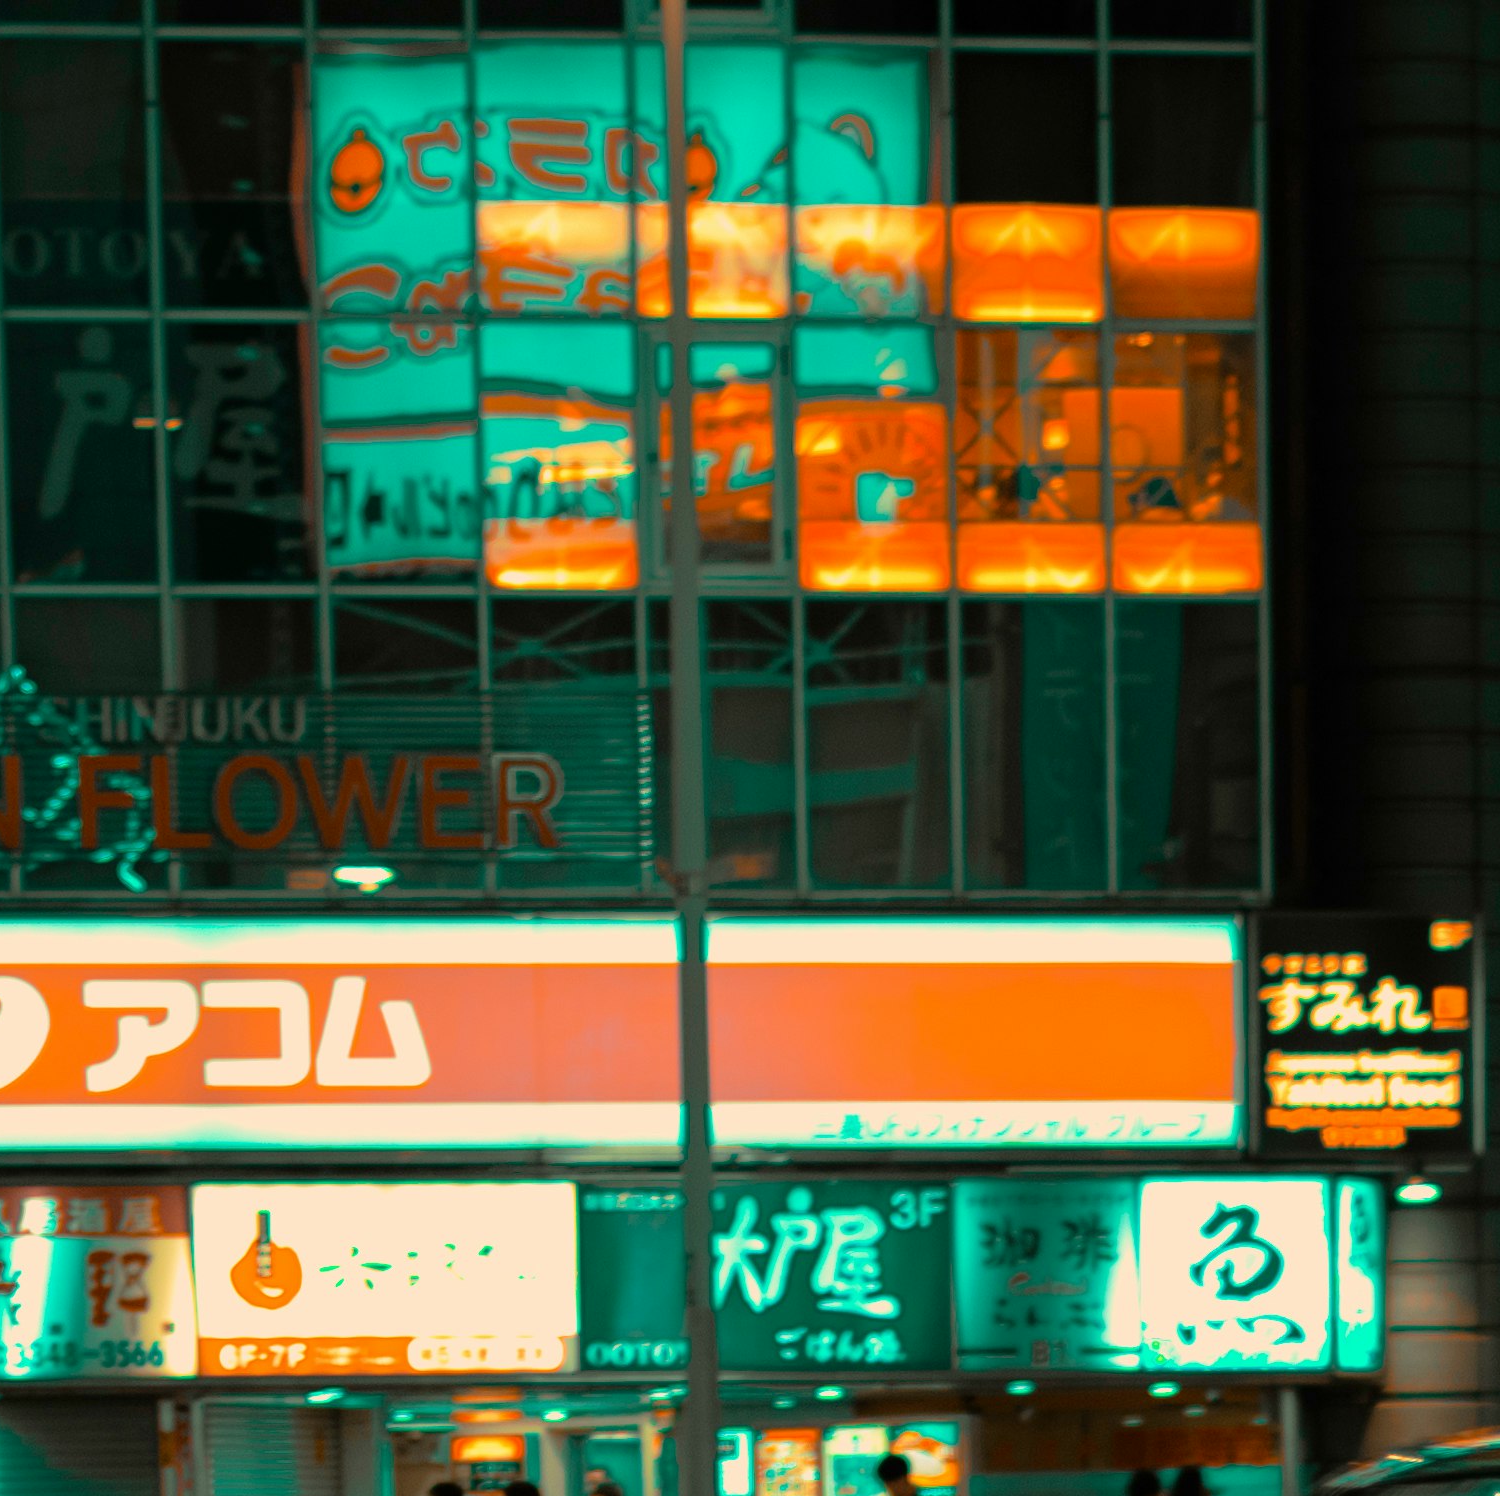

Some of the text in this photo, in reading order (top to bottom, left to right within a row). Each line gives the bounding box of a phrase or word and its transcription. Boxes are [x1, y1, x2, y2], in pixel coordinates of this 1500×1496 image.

[41, 696, 308, 745] SHINJUKU
[79, 752, 566, 856] FLOWER
[82, 975, 432, 1093] アコム
[1256, 976, 1432, 1034] すみれ
[890, 1188, 946, 1230] 3F
[713, 1186, 900, 1320] 大戸屋
